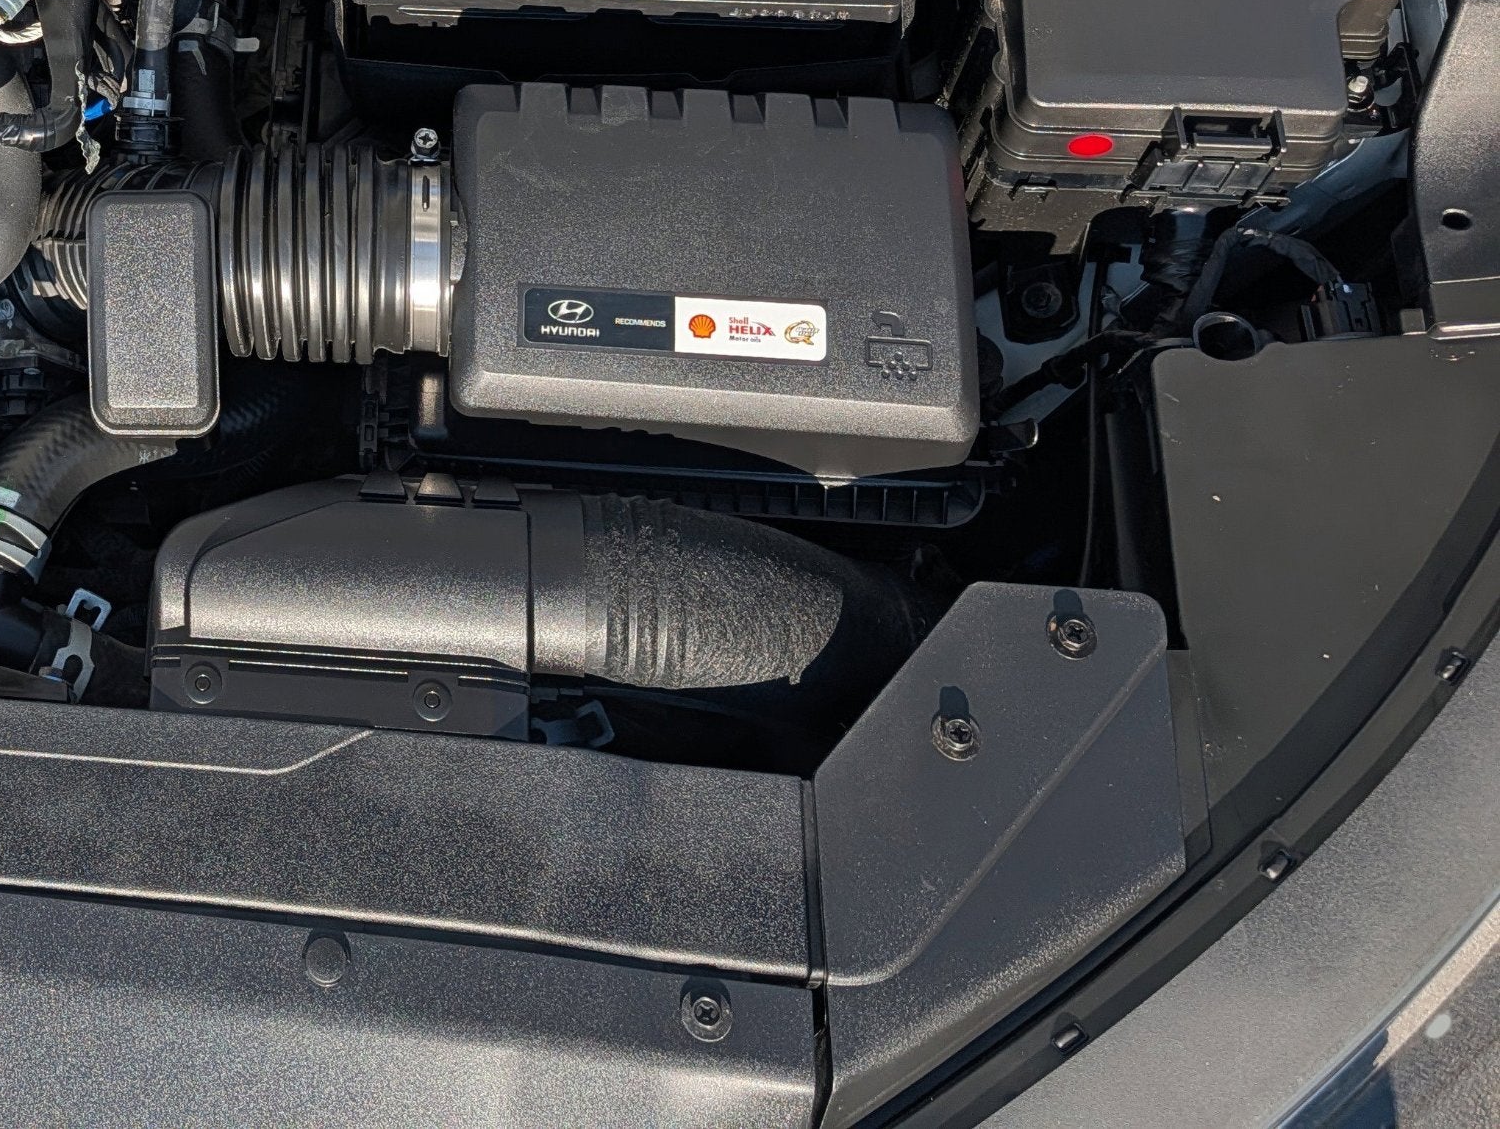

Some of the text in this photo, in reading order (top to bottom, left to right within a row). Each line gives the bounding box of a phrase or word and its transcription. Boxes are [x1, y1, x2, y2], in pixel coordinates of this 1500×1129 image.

[615, 317, 667, 328] RECOMMENDS
[540, 325, 600, 337] HYUNDAI
[729, 325, 775, 336] HELIX
